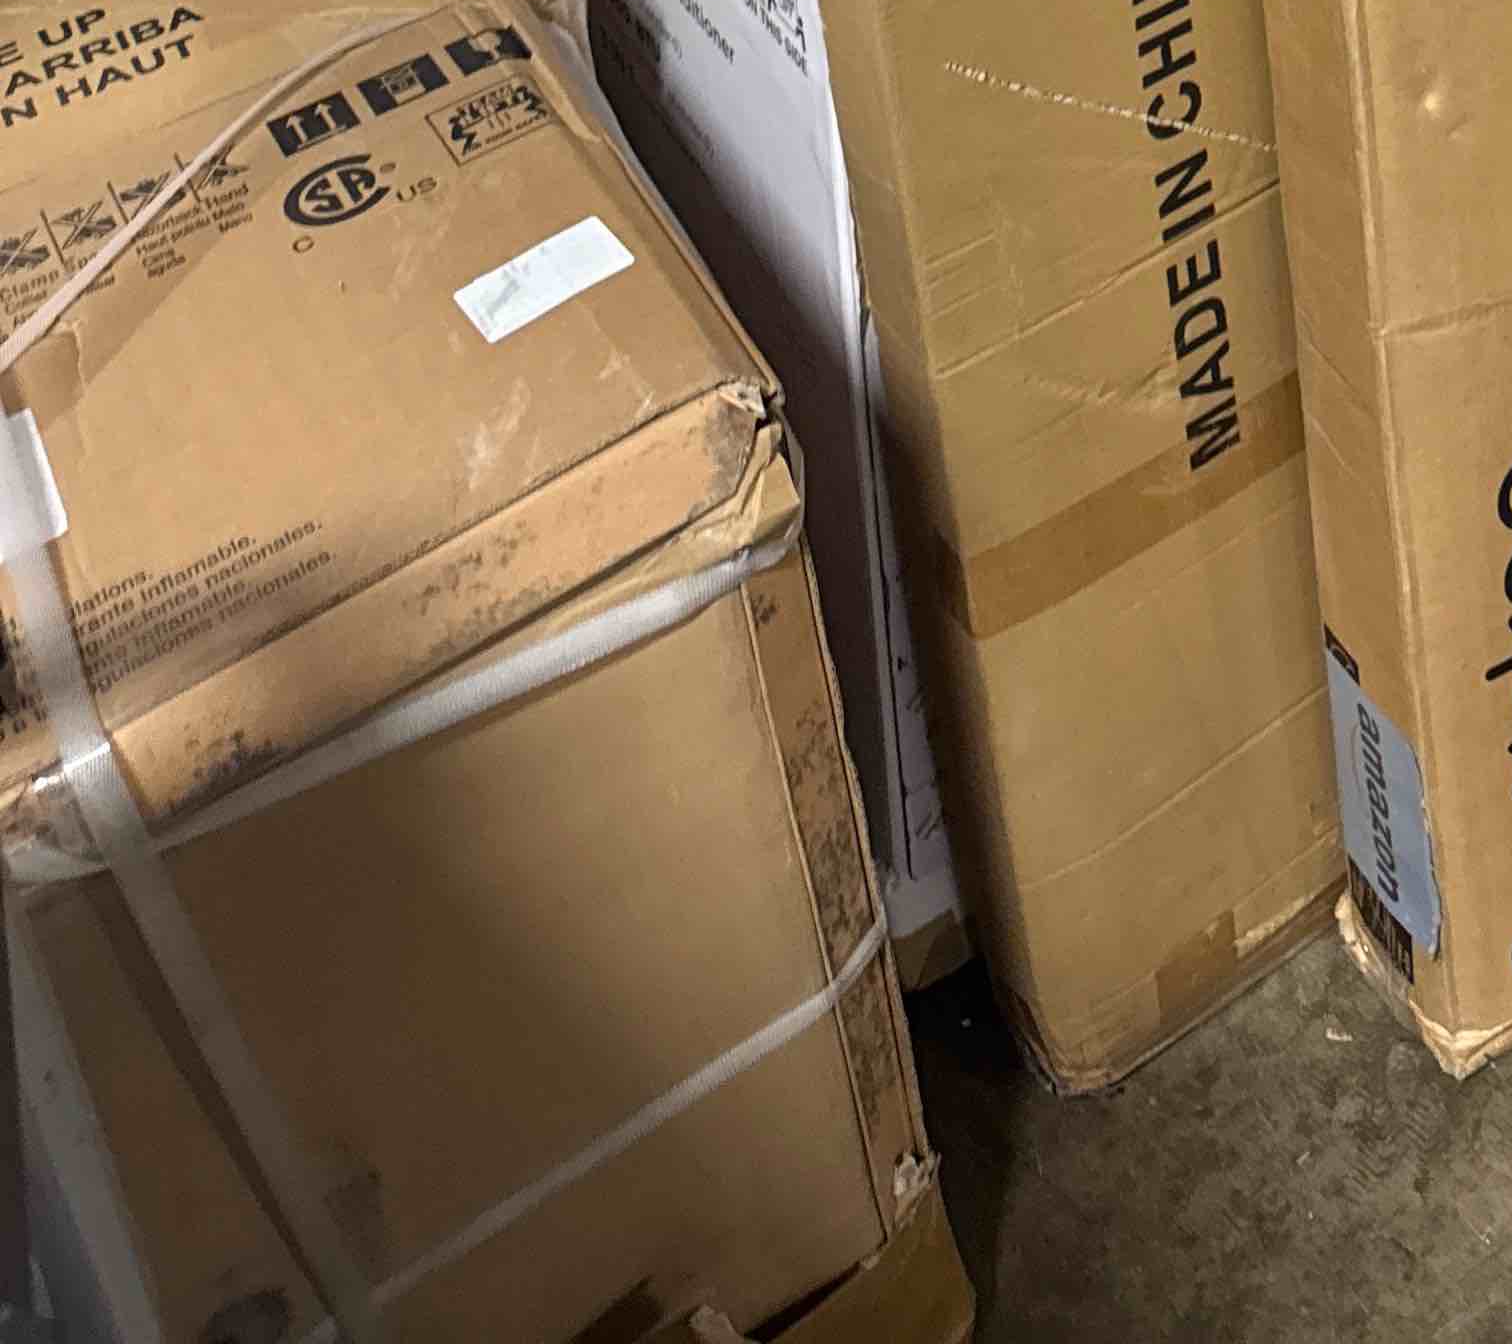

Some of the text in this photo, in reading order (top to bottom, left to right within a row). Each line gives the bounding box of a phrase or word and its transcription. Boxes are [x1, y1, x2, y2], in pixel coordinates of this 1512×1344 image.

[4, 7, 204, 97] ARRIBA
[37, 8, 106, 48] UP
[56, 33, 195, 107] HAUT
[1154, 148, 1216, 244] IN
[1165, 238, 1242, 473] MADE
[1356, 702, 1400, 904] amazon
